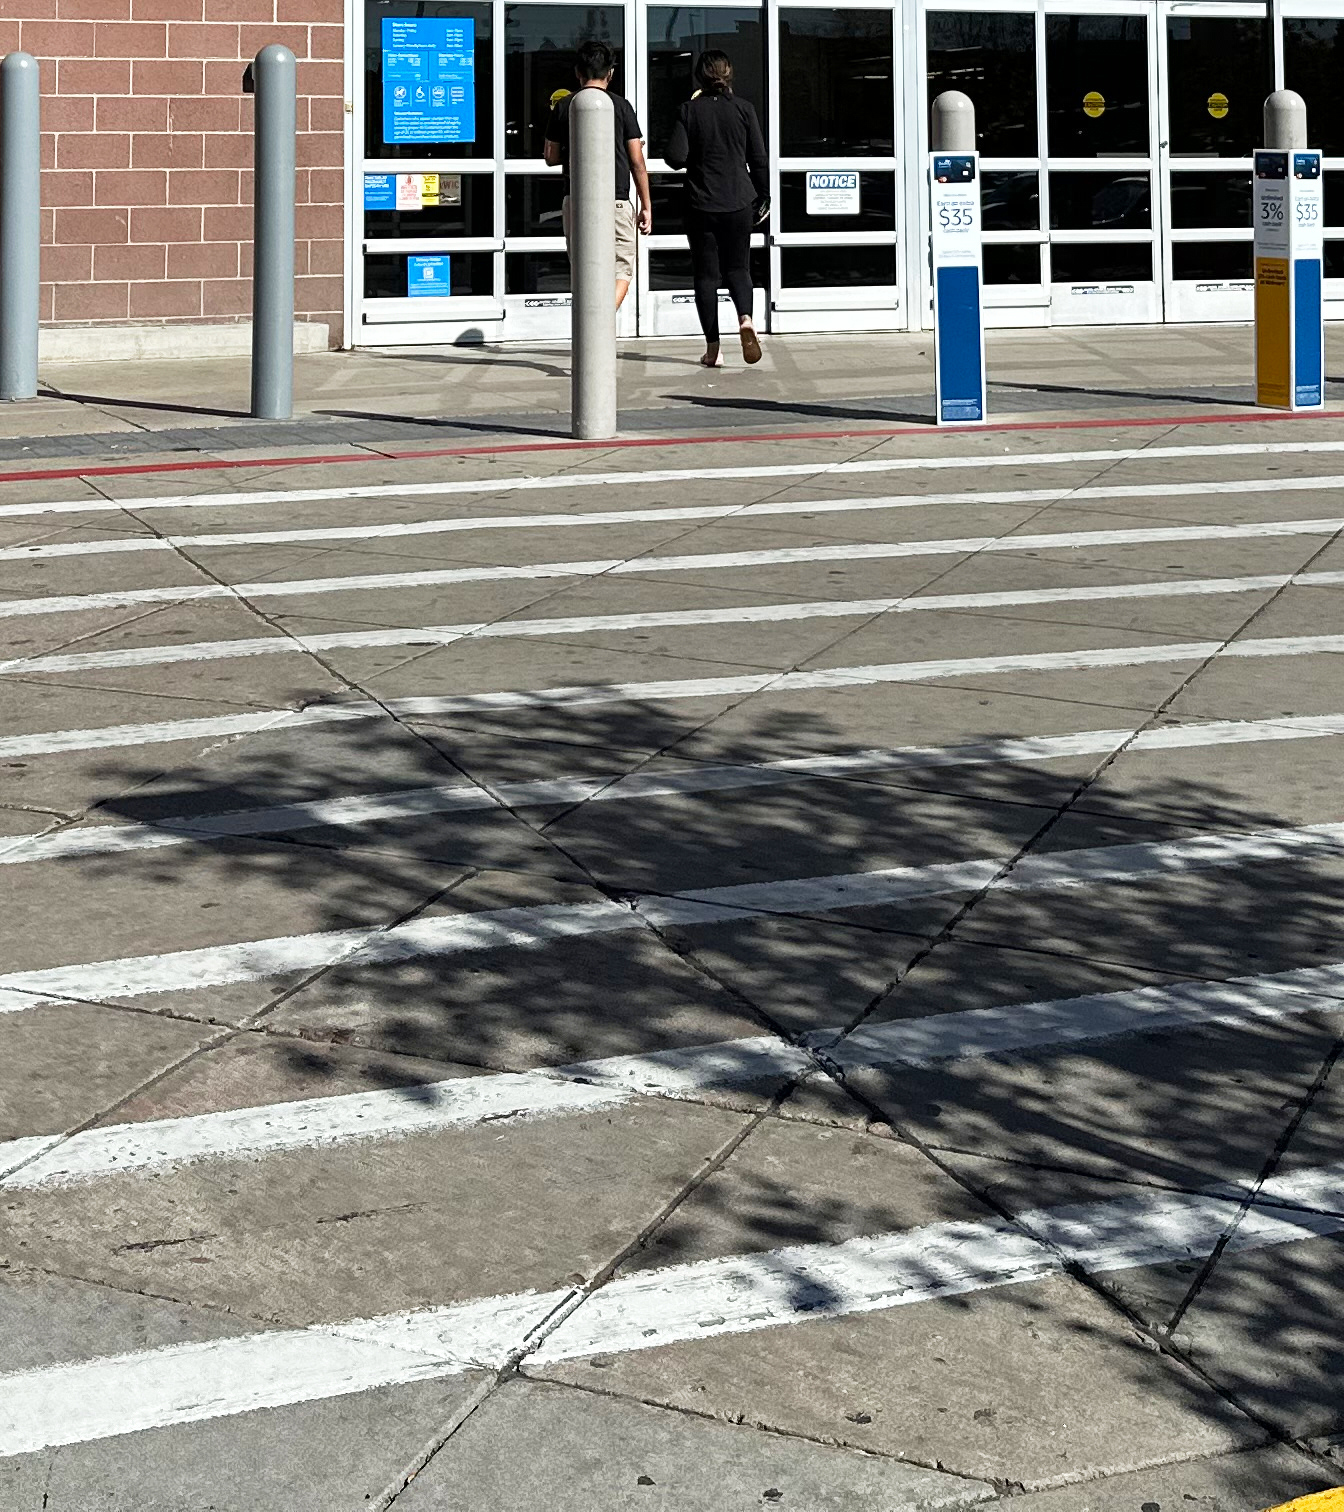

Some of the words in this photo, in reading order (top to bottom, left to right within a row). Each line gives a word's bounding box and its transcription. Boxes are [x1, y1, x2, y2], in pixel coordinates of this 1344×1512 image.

[810, 175, 856, 188] NOTICE
[939, 206, 973, 228] $35
[1261, 202, 1284, 220] 3%
[1296, 202, 1318, 222] $35
